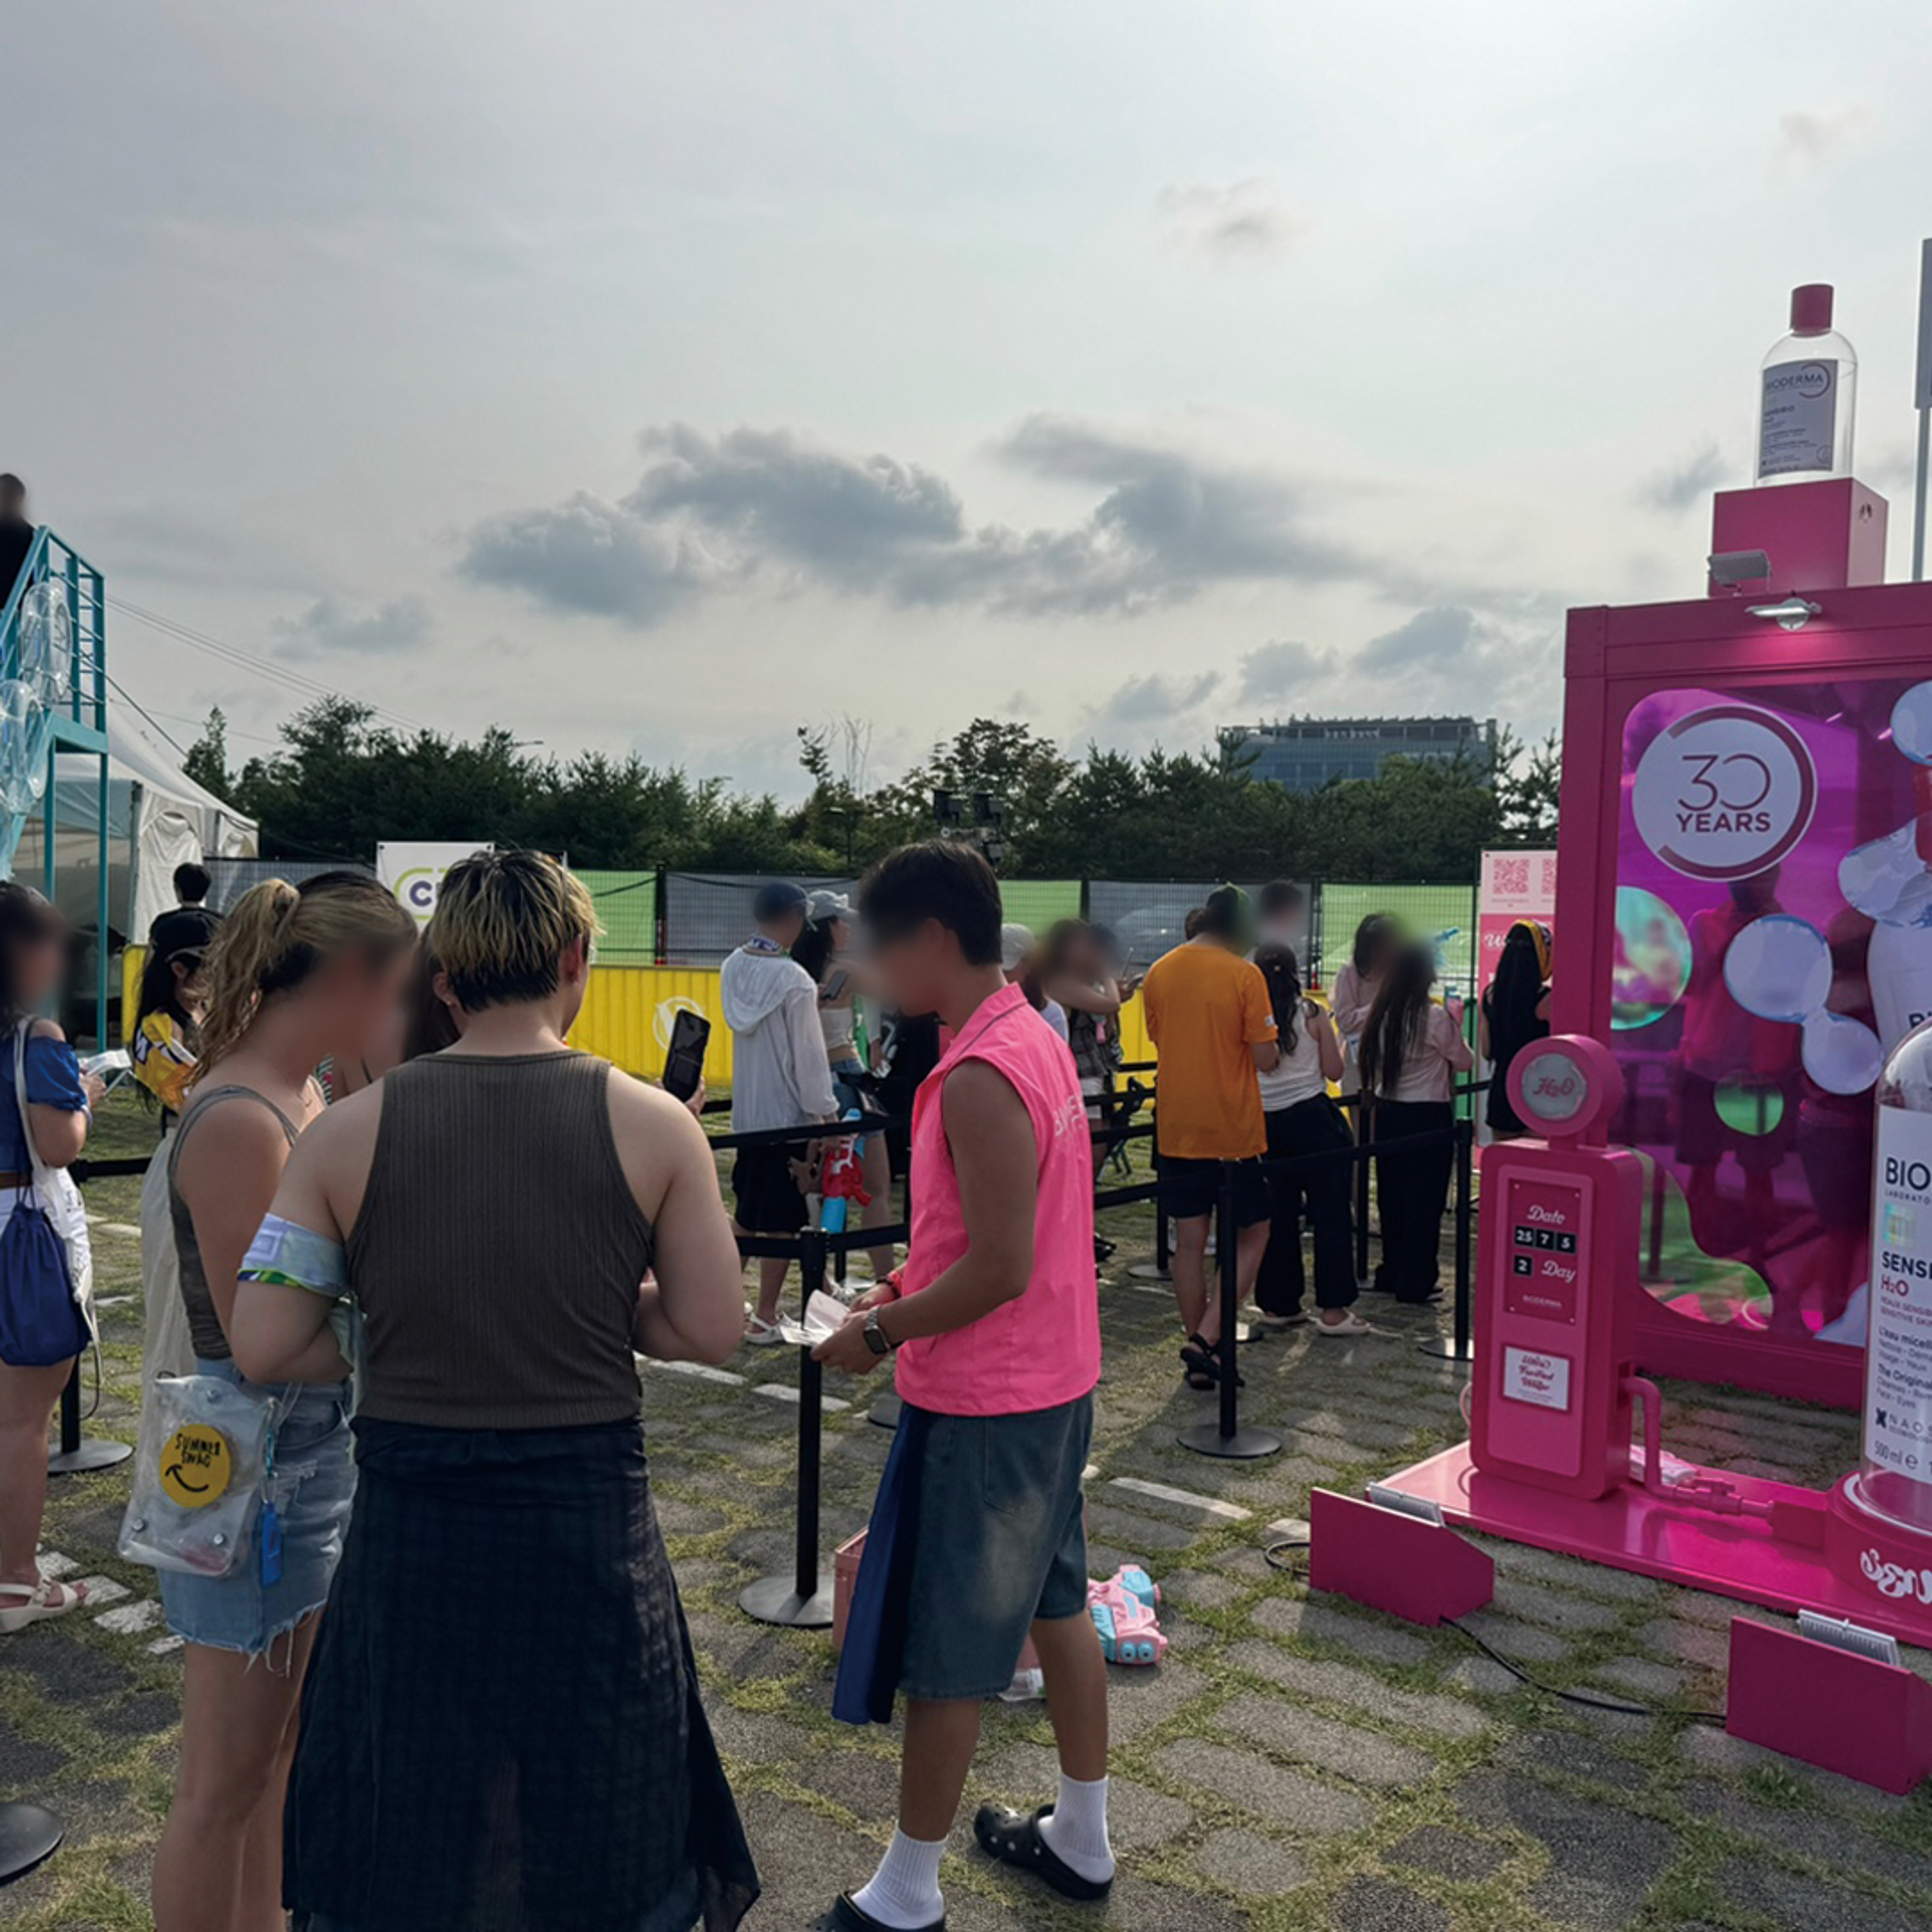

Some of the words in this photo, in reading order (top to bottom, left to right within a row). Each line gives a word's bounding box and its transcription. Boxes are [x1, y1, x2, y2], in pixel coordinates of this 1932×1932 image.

[1678, 753, 1771, 812] 30
[1675, 812, 1771, 833] YEARS
[1885, 1157, 1931, 1191] BIO
[1527, 1204, 1566, 1225] Date
[1516, 1229, 1533, 1243] 25
[1540, 1233, 1550, 1245] 7
[1561, 1237, 1570, 1249] 5
[1518, 1259, 1528, 1272] 2
[1541, 1260, 1576, 1284] Day
[175, 1433, 221, 1457] SUMMER
[182, 1449, 212, 1468] SWAG
